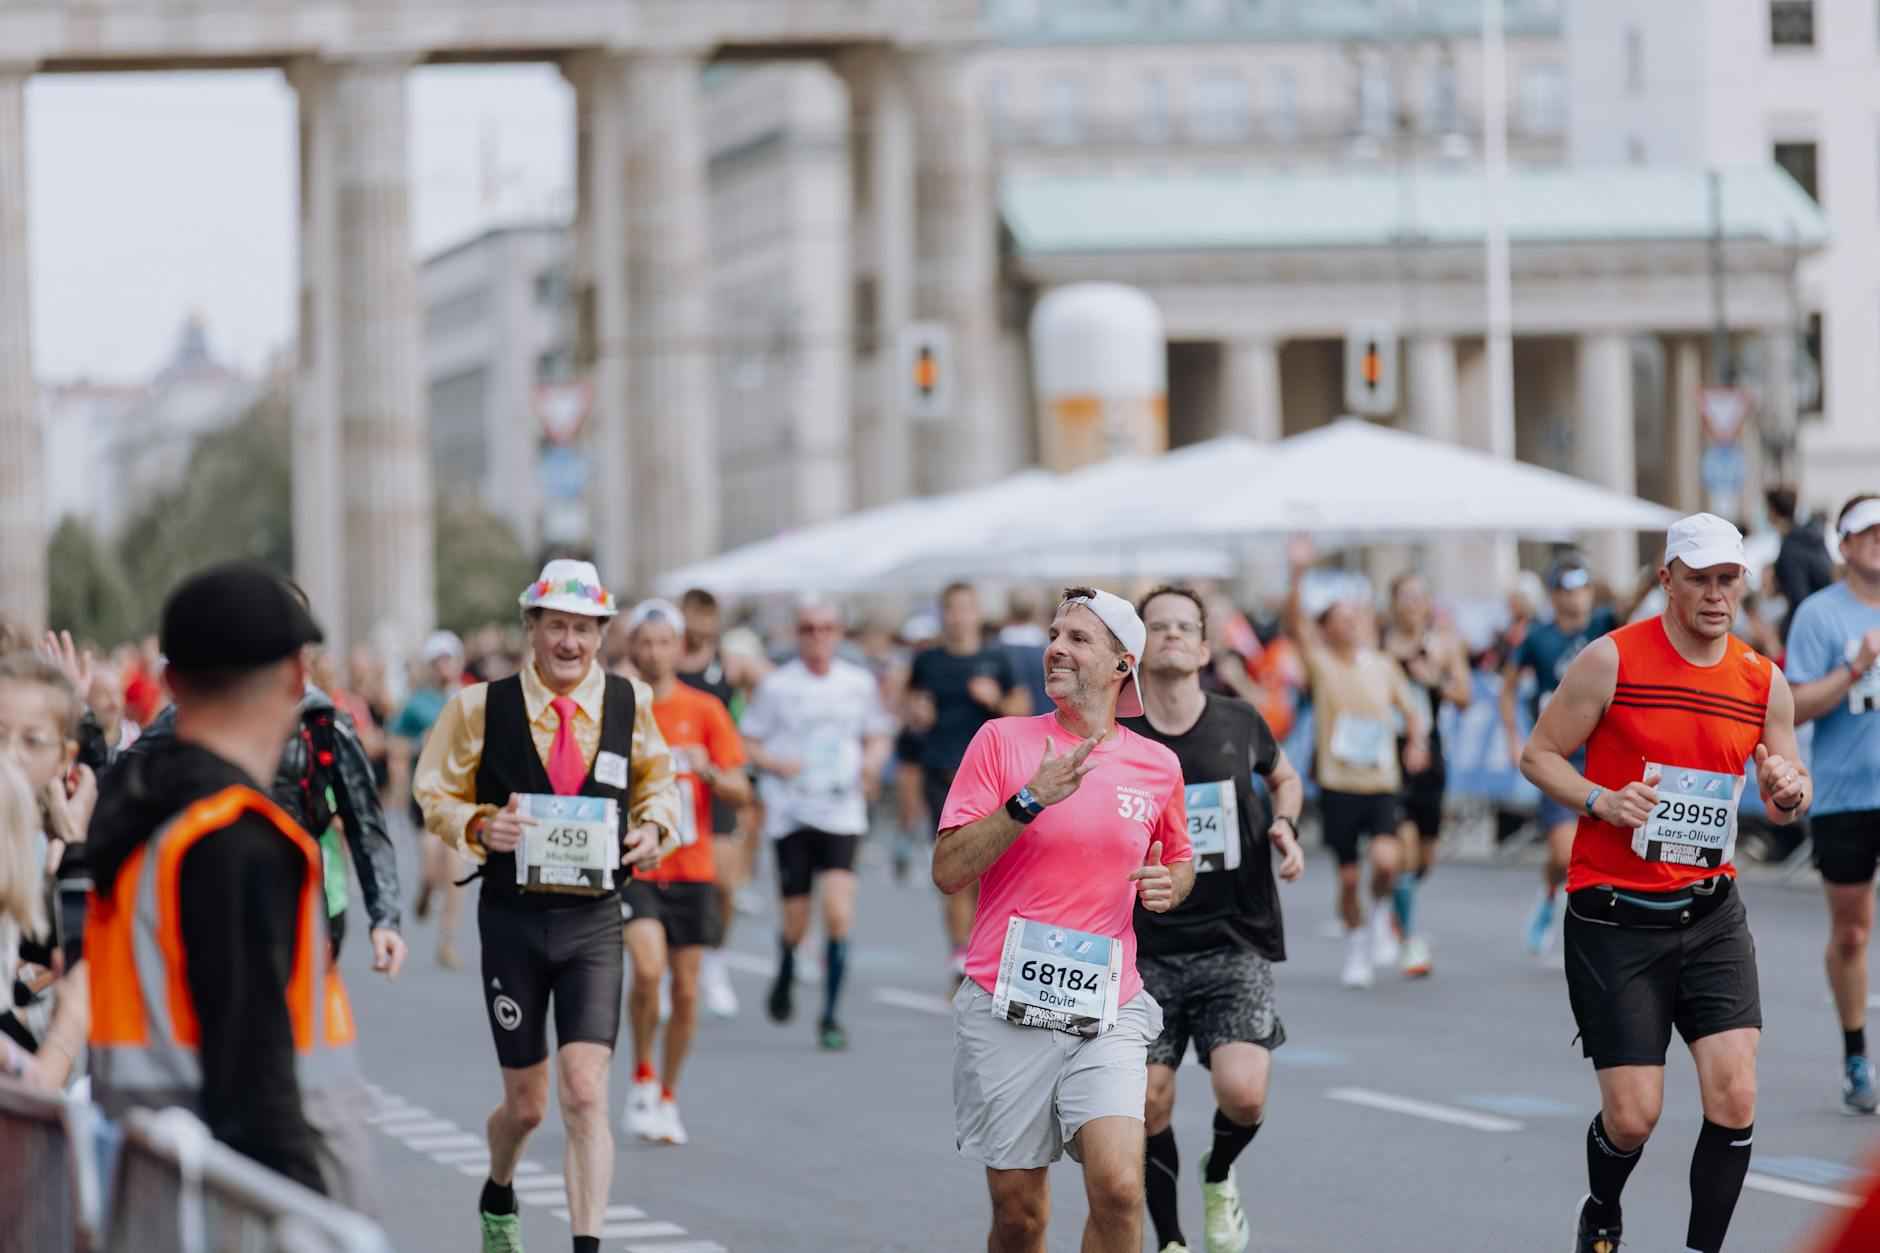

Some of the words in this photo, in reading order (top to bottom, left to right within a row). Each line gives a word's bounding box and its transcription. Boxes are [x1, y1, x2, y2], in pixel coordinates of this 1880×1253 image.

[1656, 800, 1728, 828] 29958
[547, 827, 588, 848] 459
[1657, 826, 1721, 844] Lars-Oliver
[1021, 960, 1099, 994] 68184
[1039, 990, 1077, 1008] David
[1022, 1014, 1031, 1026] IS
[1030, 1016, 1067, 1032] NOTHING
[1024, 1005, 1073, 1025] IMPOSSIBLE
